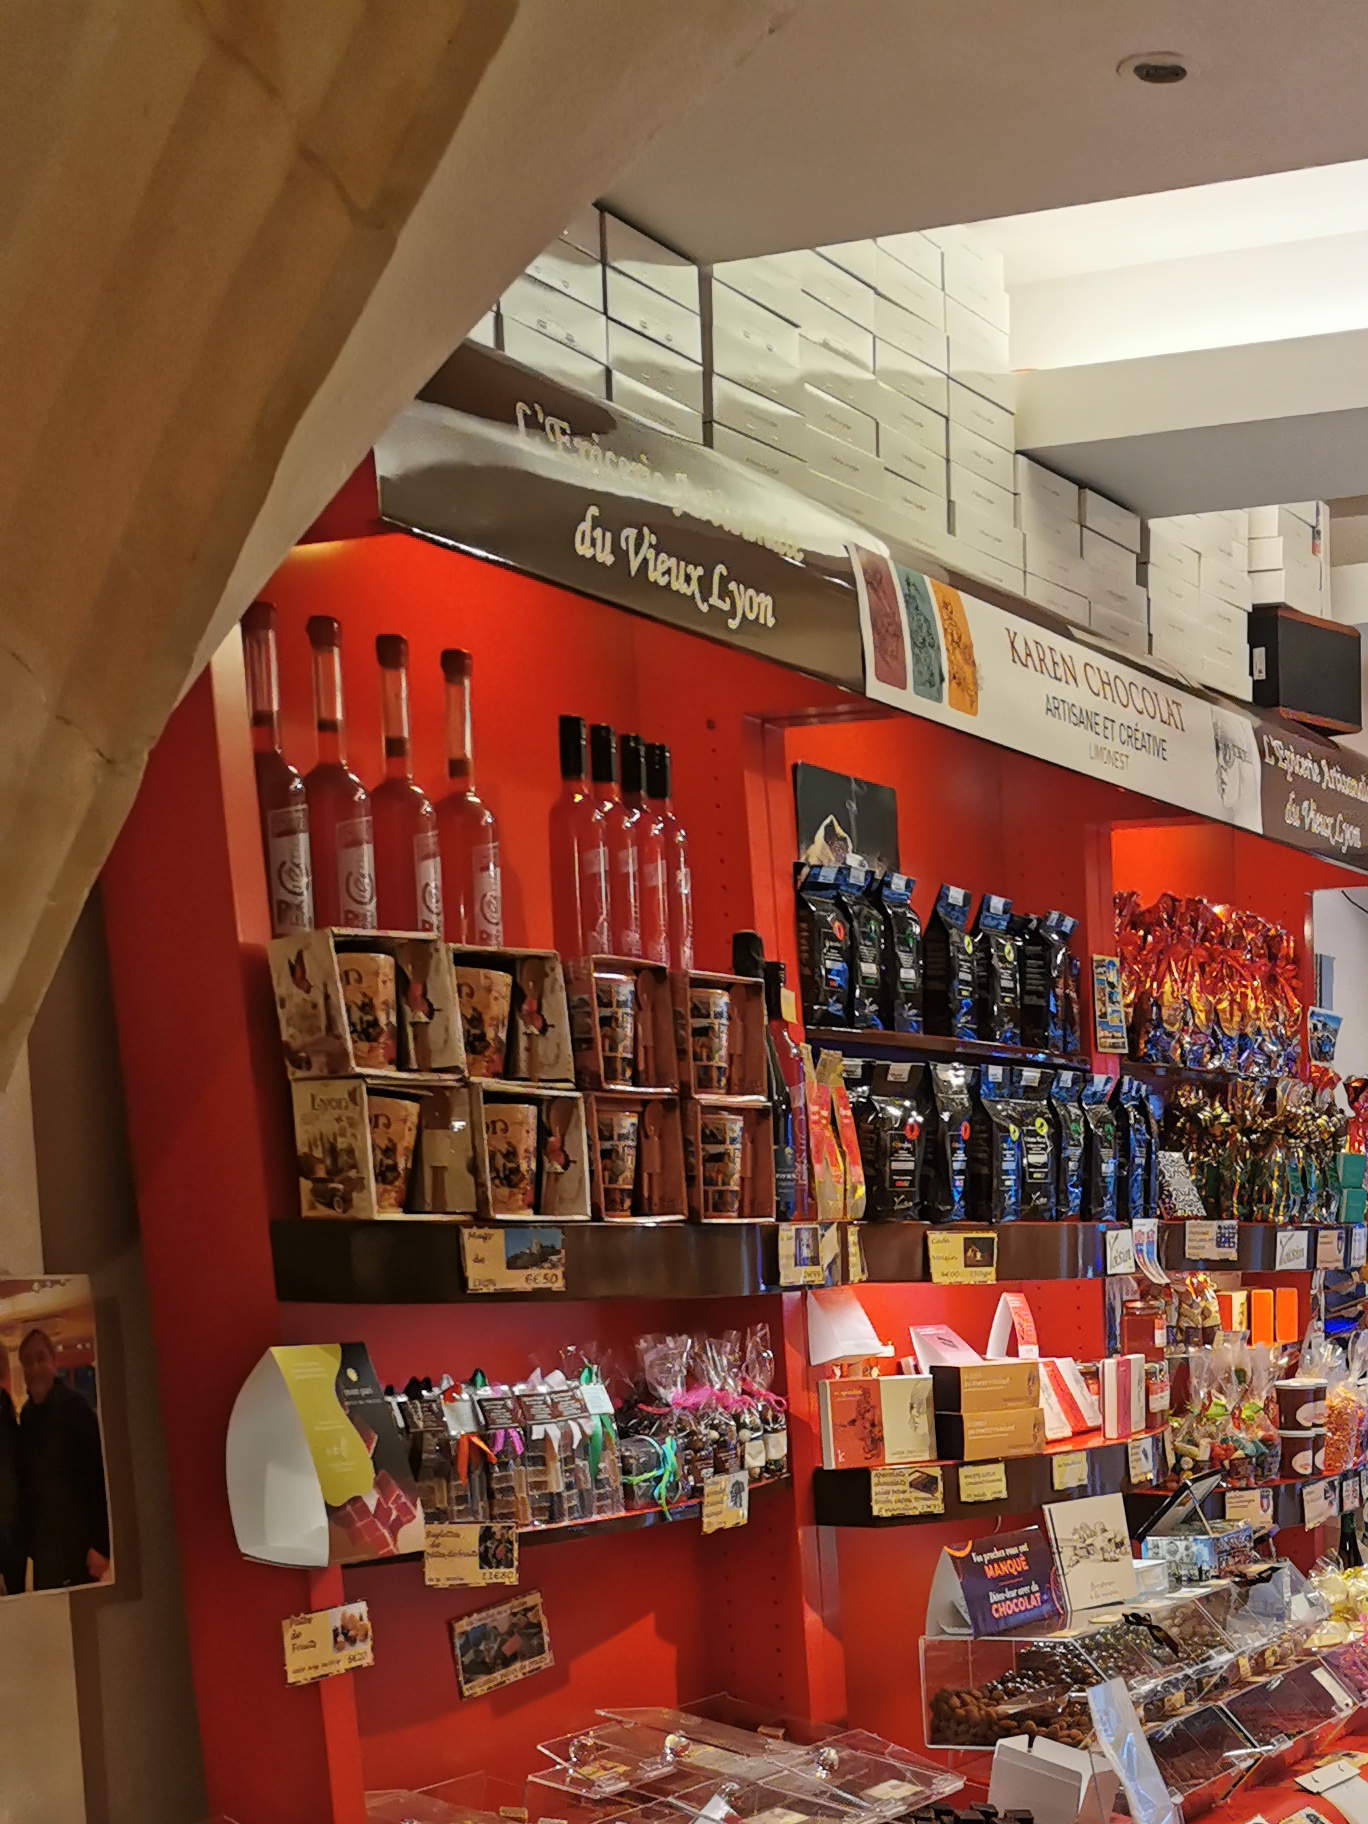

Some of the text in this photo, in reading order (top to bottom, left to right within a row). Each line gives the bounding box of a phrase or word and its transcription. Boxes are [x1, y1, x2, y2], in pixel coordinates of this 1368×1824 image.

[575, 505, 615, 566] du
[621, 526, 709, 613] Vieux
[708, 564, 776, 629] Lyon
[1005, 627, 1186, 732] KAREN CHOCOLAT
[1045, 694, 1168, 761] ARTISANE ET CRÉATIVE
[1335, 813, 1362, 853] Lyon
[984, 1554, 1029, 1579] MANQUÉ
[991, 1592, 1041, 1619] CHOCOLAT
